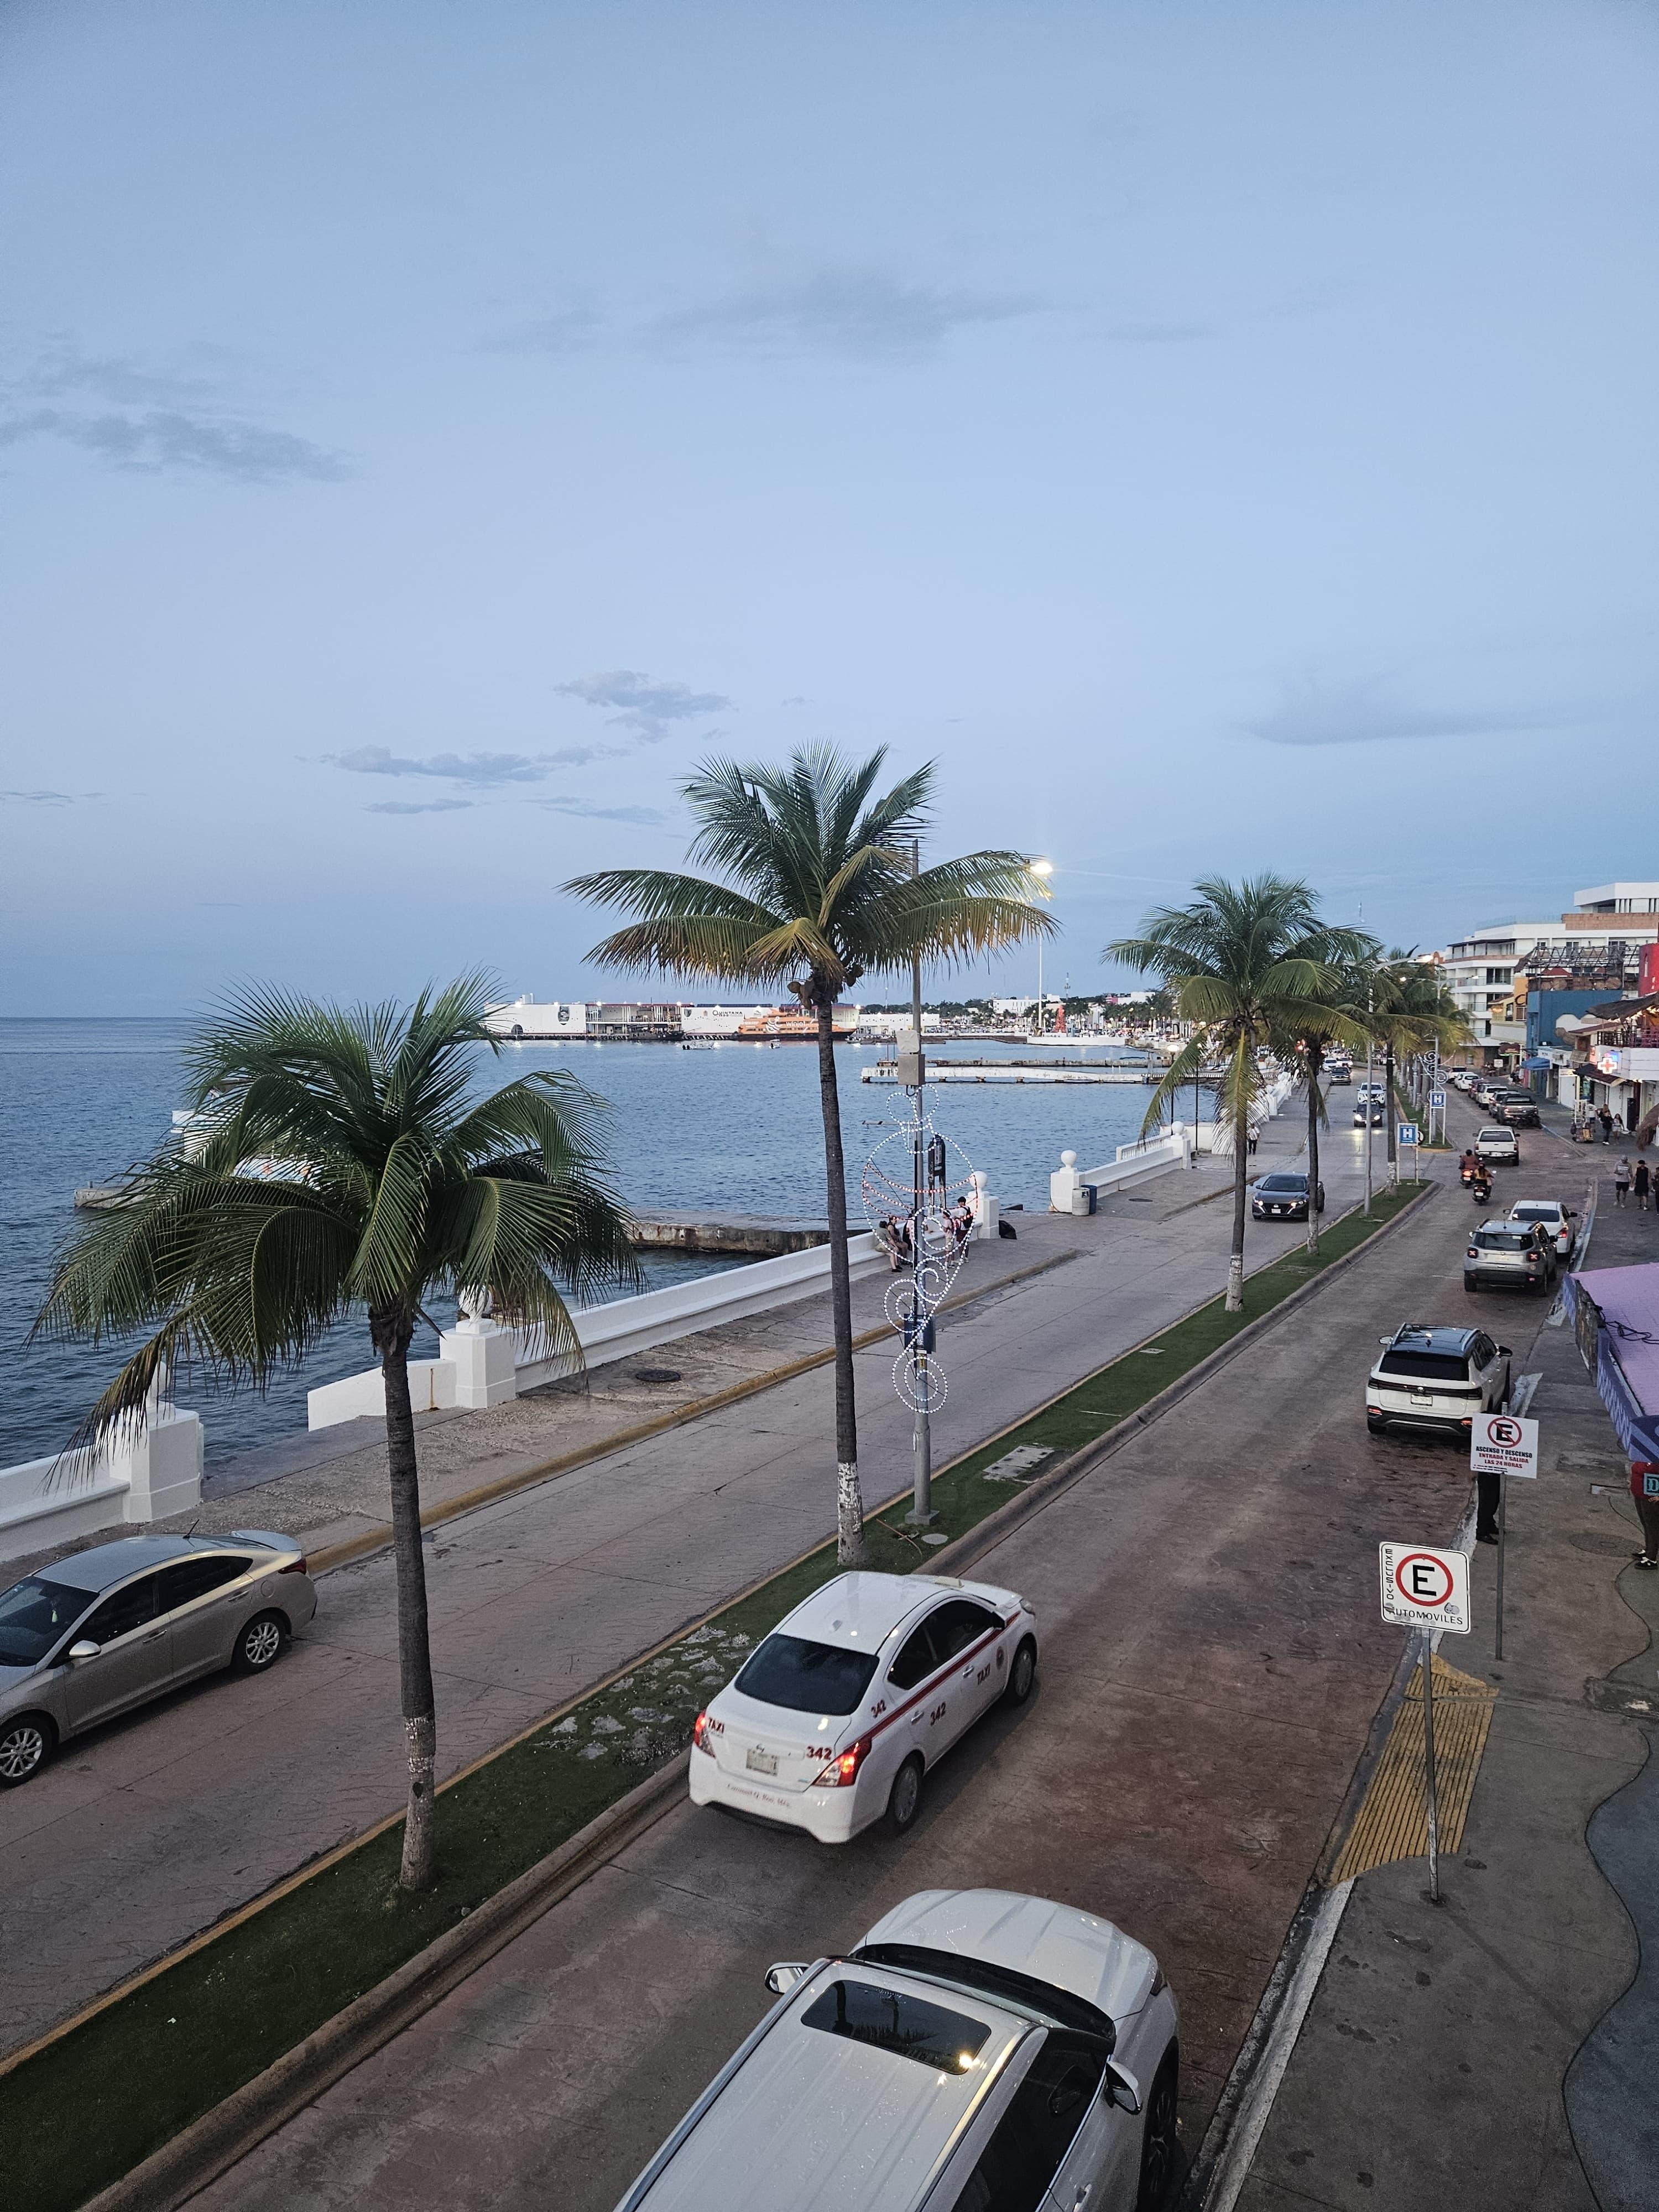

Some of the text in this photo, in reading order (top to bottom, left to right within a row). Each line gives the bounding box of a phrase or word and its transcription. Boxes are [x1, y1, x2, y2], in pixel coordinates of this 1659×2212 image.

[1403, 1129, 1412, 1138] H
[1505, 1449, 1532, 1458] DESCENSO
[1385, 1549, 1394, 1600] EXCLUSIVO
[1412, 1564, 1437, 1597] E
[977, 1663, 990, 1685] TAXI
[871, 1699, 886, 1718] 342
[930, 1702, 946, 1726] 342
[708, 1717, 725, 1734] TAXI
[806, 1746, 832, 1760] 342
